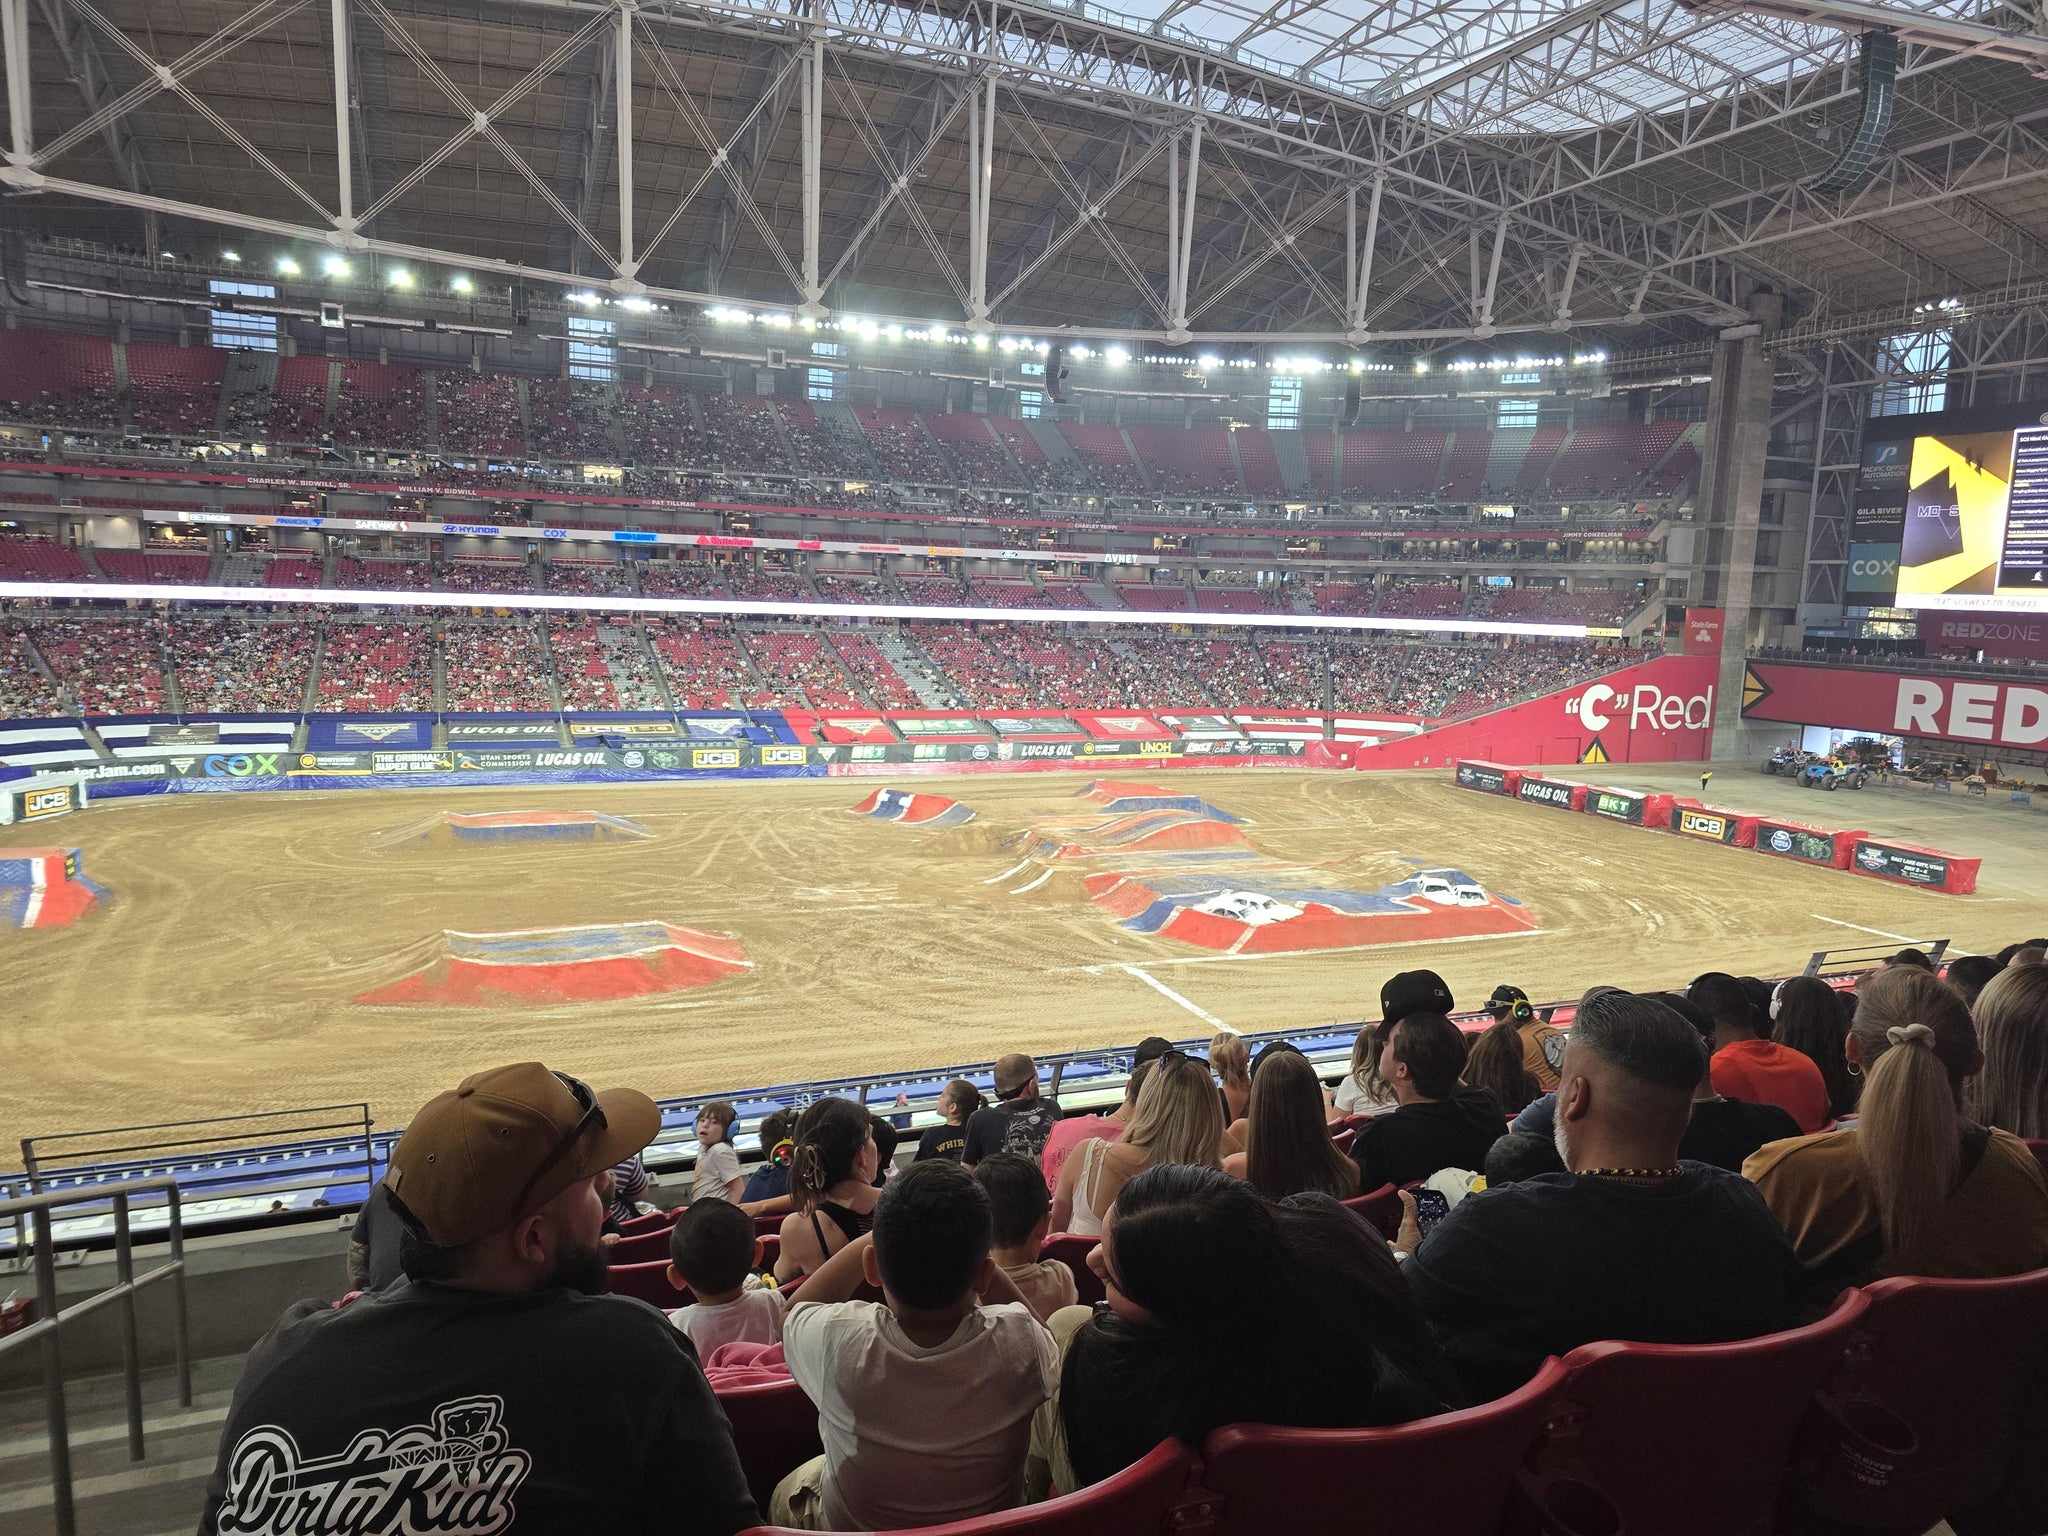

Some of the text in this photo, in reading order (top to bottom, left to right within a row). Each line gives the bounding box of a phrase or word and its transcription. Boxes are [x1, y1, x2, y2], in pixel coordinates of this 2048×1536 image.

[1863, 471, 1906, 479] AUTOMATION
[247, 477, 286, 486] CHARLES
[287, 479, 299, 487] W.
[300, 480, 337, 489] BIDWILL,
[398, 485, 434, 494] WILLIAM
[444, 488, 477, 496] BIDWILL
[666, 500, 696, 508] TILLMAN
[189, 512, 231, 522] BETMGM
[355, 520, 398, 530] SAFEWAY
[459, 526, 500, 535] HYUNDAI
[543, 529, 567, 538] COX
[1852, 559, 1896, 576] COX
[1941, 621, 2041, 642] REDZONE
[1630, 684, 1713, 730] Red
[1893, 678, 2048, 744] RED
[449, 725, 557, 734] LUCAS OIL
[1021, 745, 1055, 757] LUCAS
[1140, 742, 1171, 753] UNOH
[375, 753, 438, 762] THE ORIGINAL
[535, 753, 580, 766] LUCAS
[695, 752, 736, 764] JCB
[765, 750, 803, 761] JCB
[204, 754, 279, 777] COX
[375, 762, 436, 771] SUPER GLUE
[1521, 783, 1551, 803] LUCAS
[29, 791, 67, 811] JCB
[1598, 796, 1629, 813] BKT
[1684, 817, 1721, 835] JCB
[1902, 858, 1916, 866] LAKE
